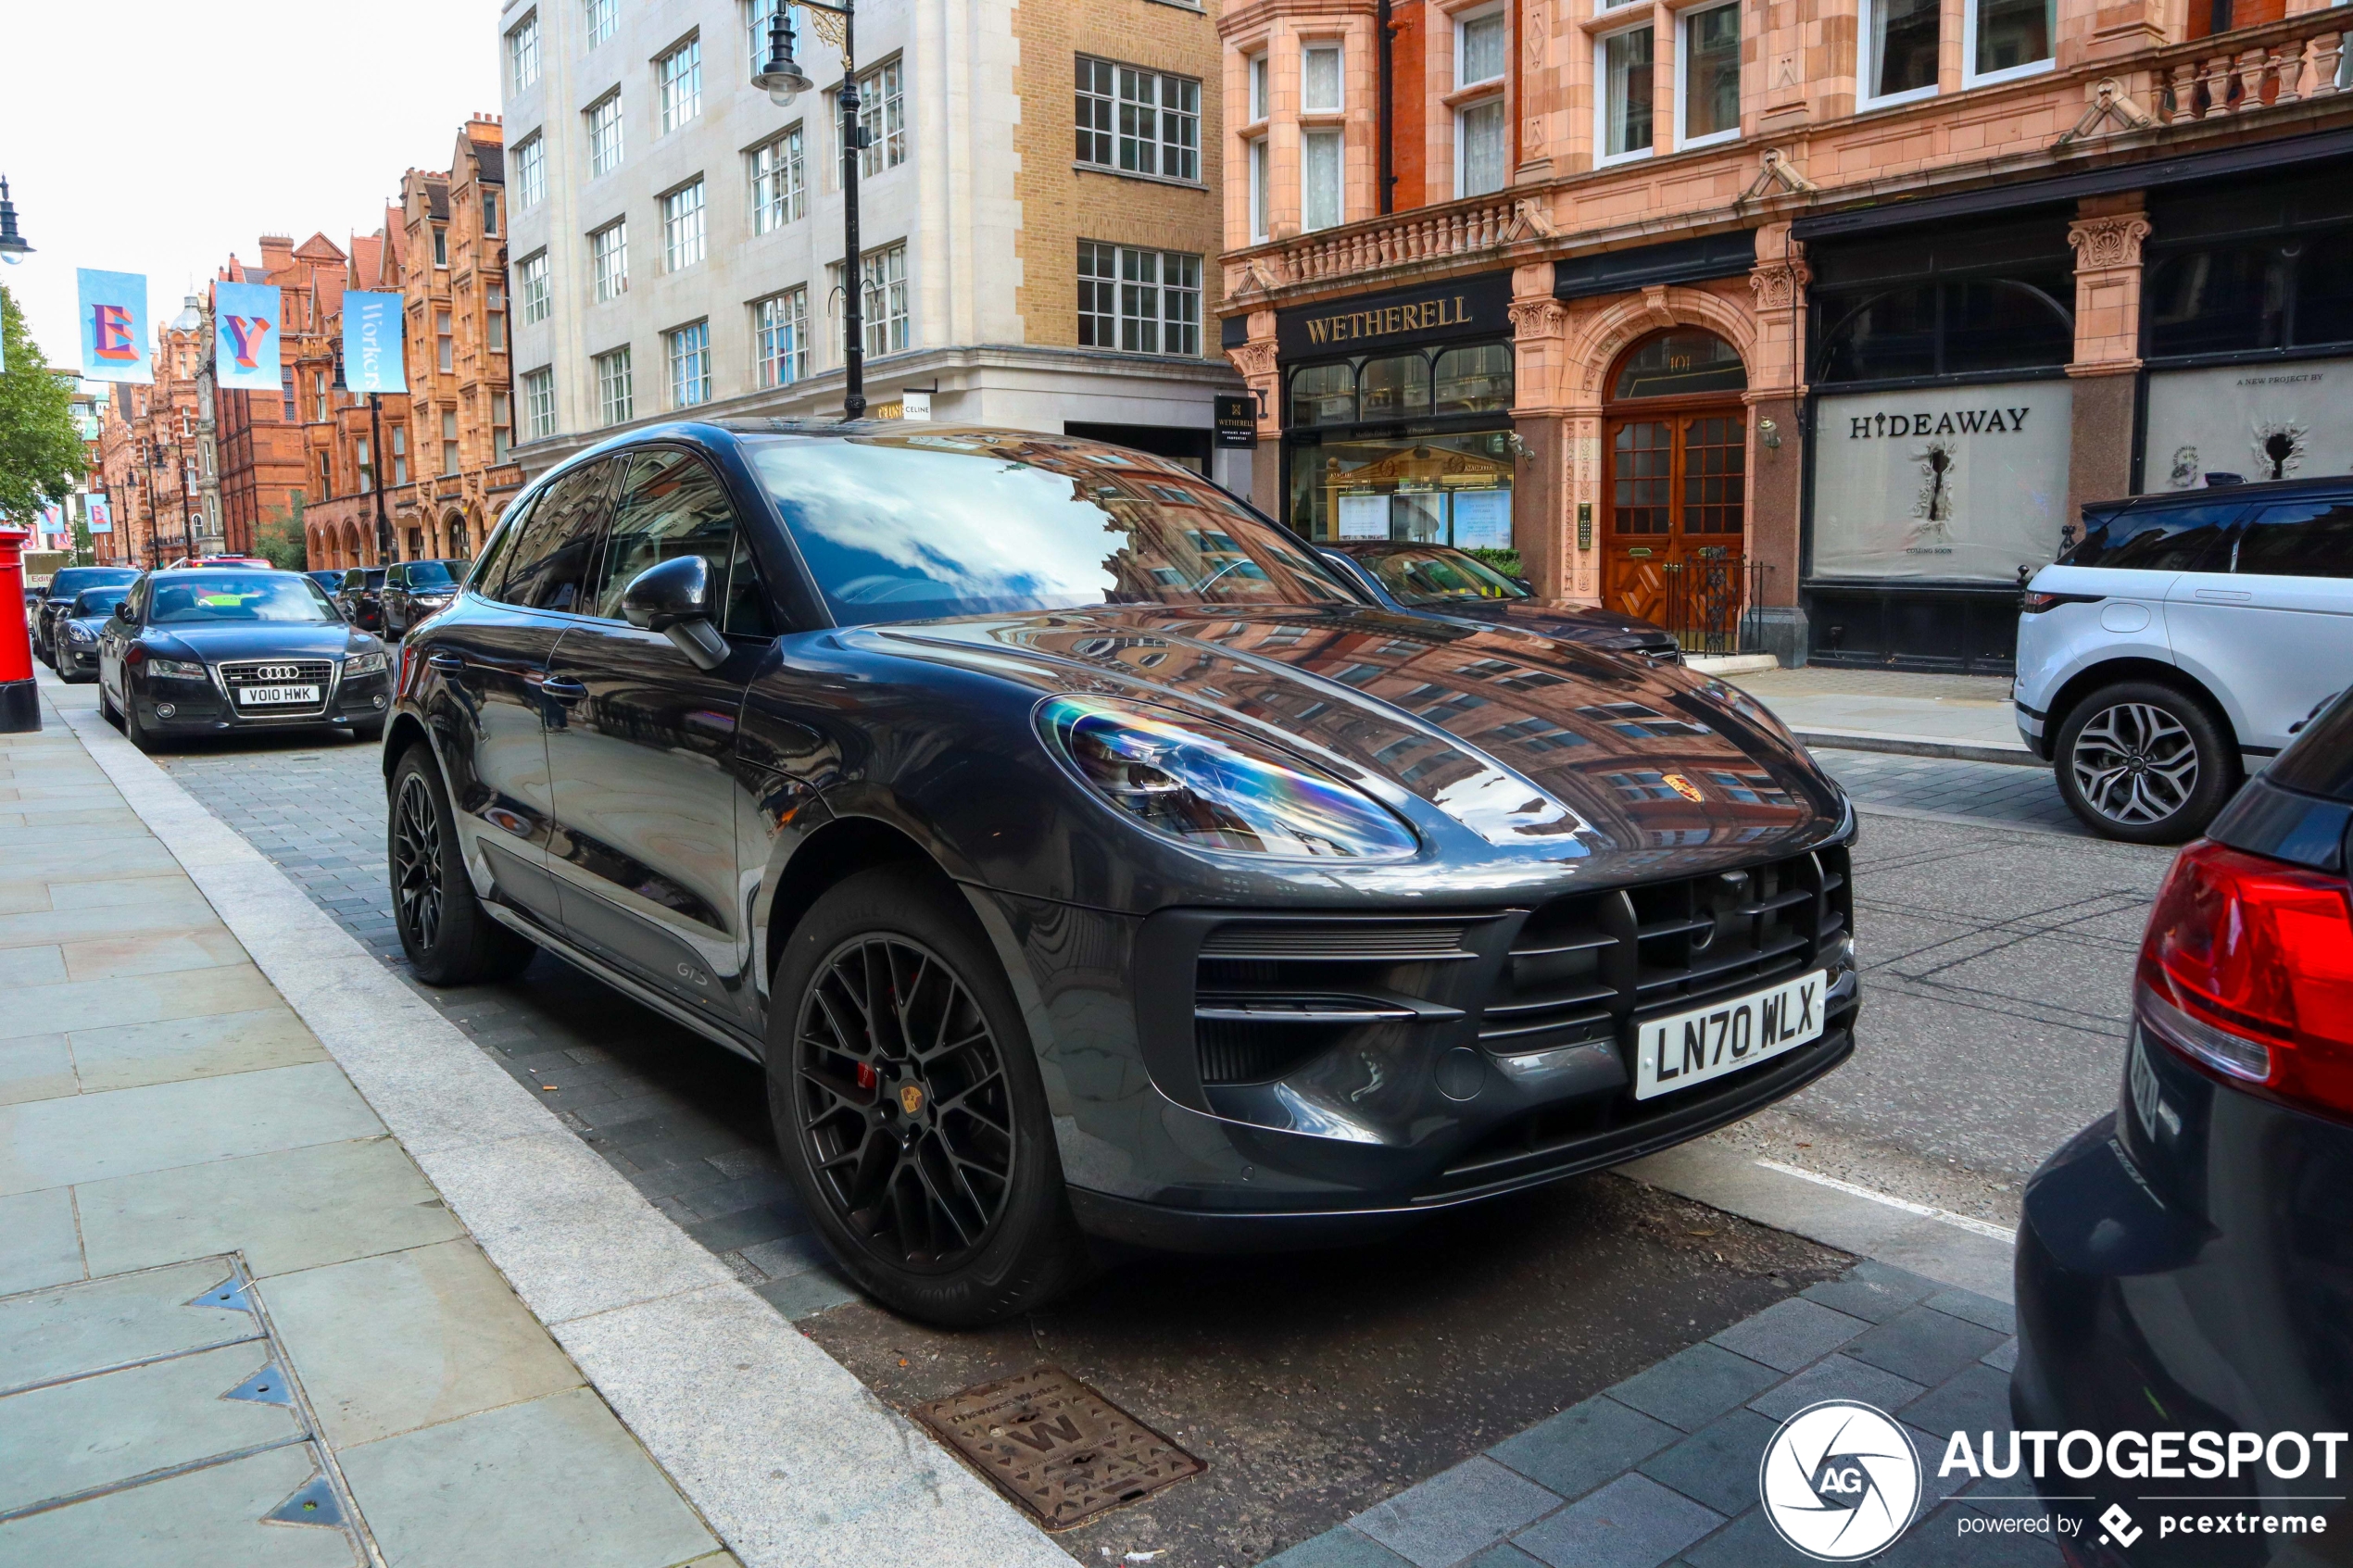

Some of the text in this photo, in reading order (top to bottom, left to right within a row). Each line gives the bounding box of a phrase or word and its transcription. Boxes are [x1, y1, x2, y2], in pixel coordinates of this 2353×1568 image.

[91, 303, 140, 361] E
[1305, 295, 1473, 345] WETHERELL
[222, 314, 271, 369] Y
[362, 303, 383, 390] Workers
[1670, 355, 1690, 372] 101
[2268, 374, 2309, 384] PROJECT
[905, 406, 929, 414] CELINE
[1218, 419, 1254, 427] WETHERELL
[90, 505, 108, 524] E
[249, 687, 311, 702] VO10 HWK
[677, 962, 708, 986] GTS
[1656, 981, 1816, 1083] LN70 WLX
[946, 1384, 1063, 1425] Thames Water
[1005, 1414, 1084, 1453] W
